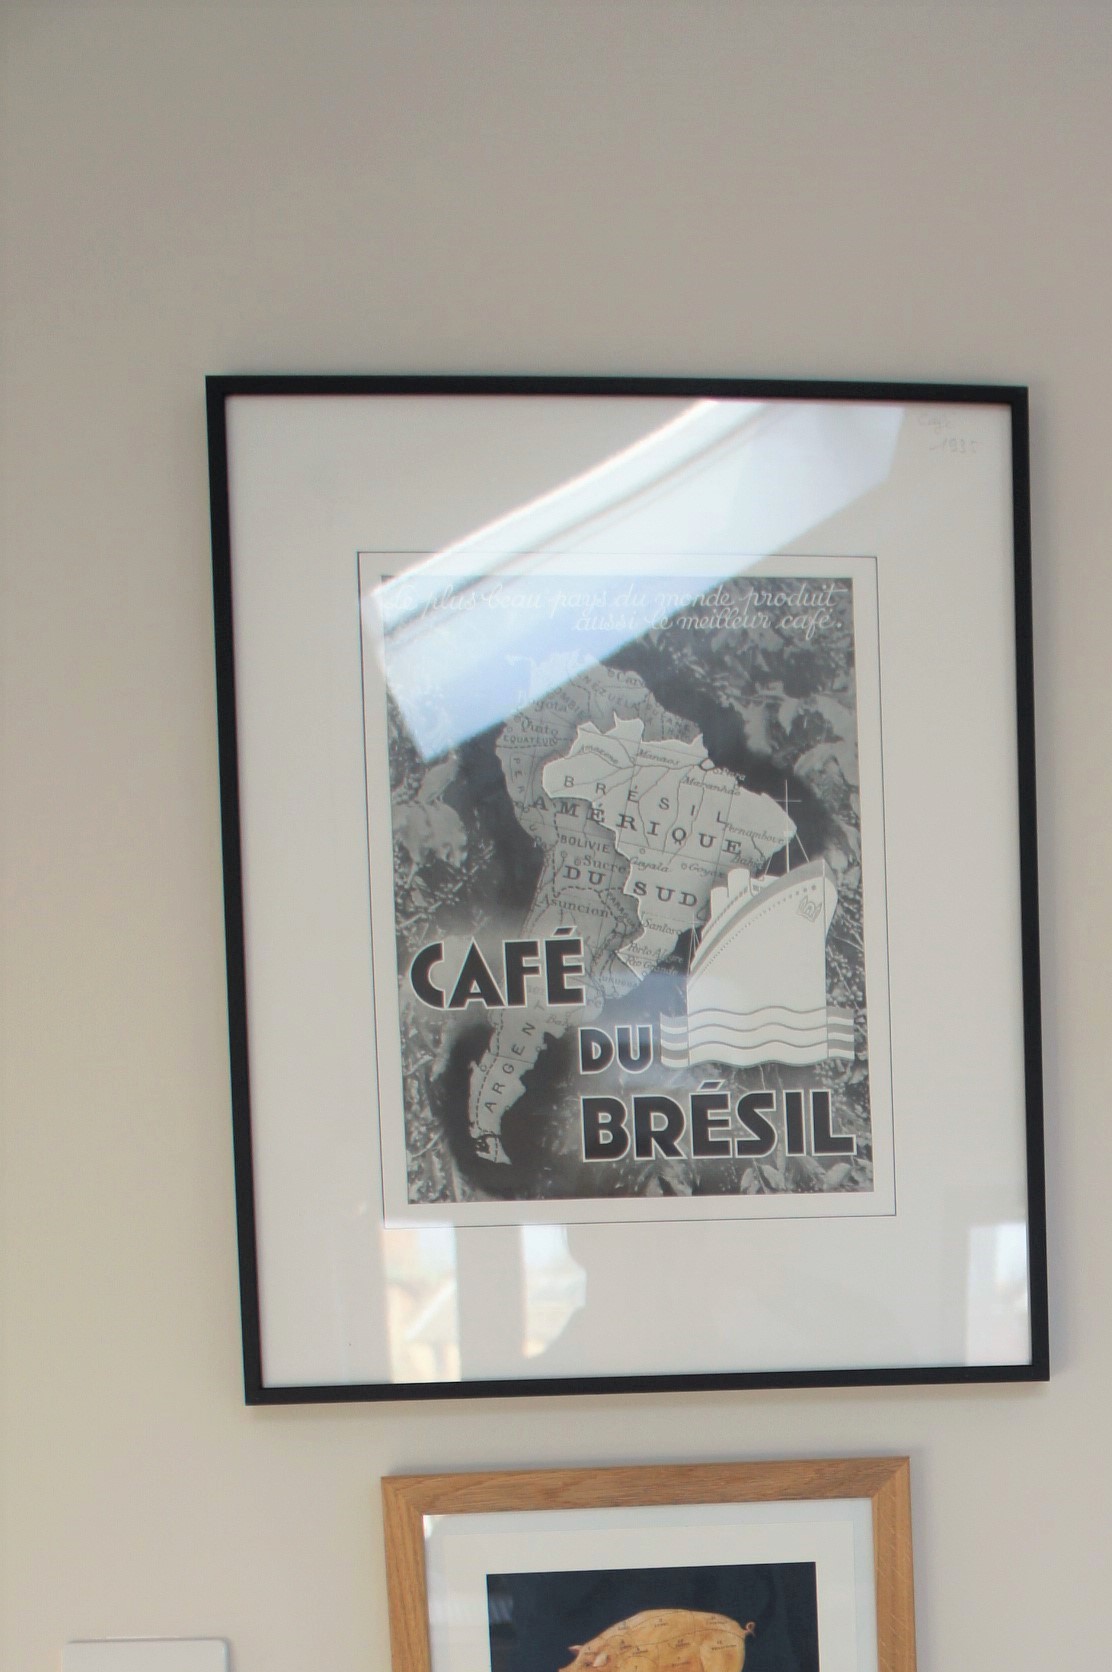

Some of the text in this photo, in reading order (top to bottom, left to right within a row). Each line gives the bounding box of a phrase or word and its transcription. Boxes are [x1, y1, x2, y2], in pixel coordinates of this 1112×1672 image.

[422, 584, 476, 618] plus
[482, 584, 542, 609] beau
[549, 589, 607, 618] pays
[613, 583, 648, 607] du
[659, 584, 736, 607] monde
[737, 582, 848, 614] produit
[572, 608, 842, 641] aussi le meilleur café.
[563, 774, 728, 827] BRÉSIL
[528, 796, 742, 856] AMÉRIQUE
[560, 834, 611, 854] BOLIVIE
[562, 865, 698, 907] DU SUD
[583, 855, 627, 874] Sucre
[409, 925, 588, 1011] CAFÉ
[577, 1024, 655, 1076] DU
[580, 1079, 859, 1164] BRÉSIL
